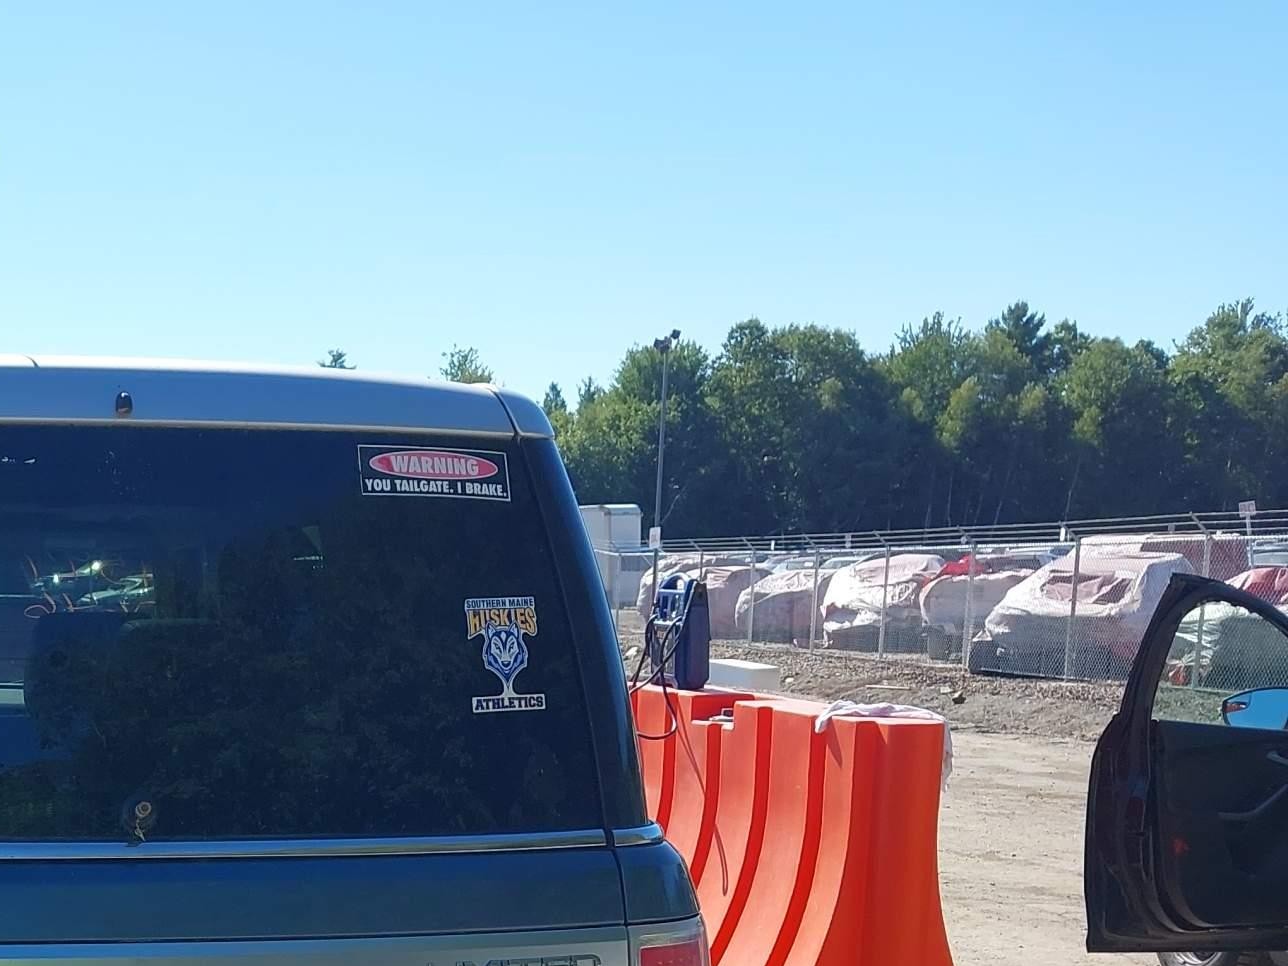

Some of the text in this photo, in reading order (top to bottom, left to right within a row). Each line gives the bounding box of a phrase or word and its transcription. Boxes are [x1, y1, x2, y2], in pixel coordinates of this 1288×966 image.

[390, 455, 479, 475] WARNING
[365, 478, 507, 496] YOU TAILGATE. I BRAKE.
[466, 598, 534, 609] SOUTHERN MAINE
[468, 608, 537, 635] HUSKIES
[475, 696, 544, 711] ATHLETICS
